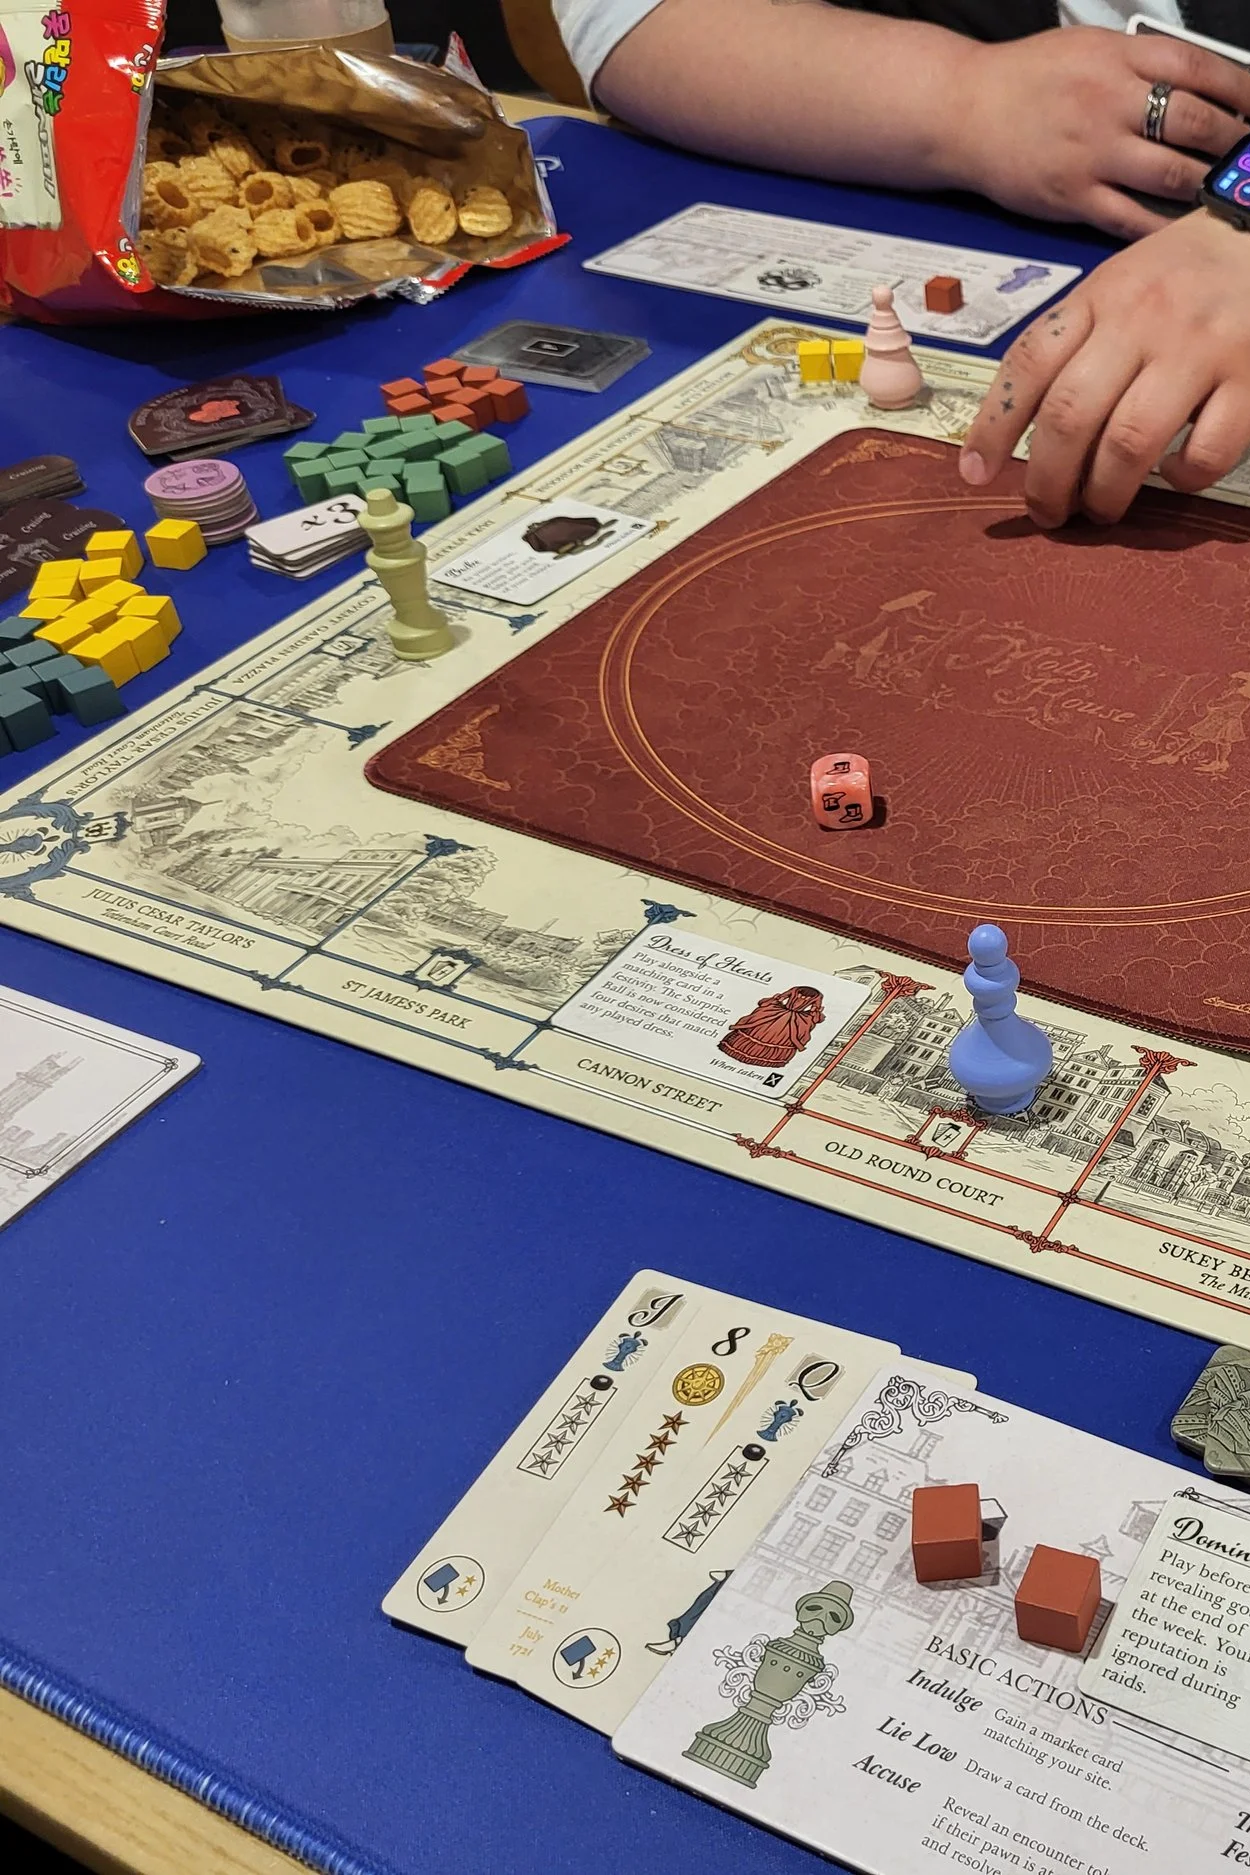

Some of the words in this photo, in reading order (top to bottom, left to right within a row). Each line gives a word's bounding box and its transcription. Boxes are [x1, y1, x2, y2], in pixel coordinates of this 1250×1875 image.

[21, 510, 52, 534] Cruising
[62, 520, 98, 542] Cruising
[178, 696, 223, 727] JULIUS
[136, 725, 178, 755] CESAR
[66, 749, 138, 797] TAYLOR'S
[82, 888, 138, 910] JULIUS
[137, 905, 184, 926] CESAR
[185, 920, 256, 949] TAYLOR'S
[153, 925, 186, 941] Court
[184, 935, 216, 950] Road
[621, 962, 676, 986] matching
[675, 978, 702, 993] card
[632, 951, 657, 967] Play
[658, 961, 717, 984] alongside
[649, 934, 690, 957] Dress
[715, 956, 773, 983] Hearts
[342, 979, 366, 994] ST
[361, 984, 428, 1020] JAMES'S
[424, 1006, 474, 1030] PARK
[602, 981, 627, 996] Ball
[638, 993, 664, 1007] now
[664, 1001, 729, 1029] considered
[611, 971, 657, 992] festivity.
[660, 986, 683, 999] The
[684, 993, 732, 1016] Surprise
[580, 1002, 603, 1016] any
[601, 1006, 645, 1028] played
[643, 1021, 676, 1039] dress.
[617, 998, 657, 1018] desires
[657, 1013, 681, 1028] that
[682, 1021, 719, 1039] match
[577, 1057, 652, 1089] CANNON
[652, 1080, 722, 1113] STREET
[708, 1058, 737, 1073] When
[736, 1067, 765, 1082] taken
[824, 1140, 863, 1165] OLD
[864, 1152, 933, 1185] ROUND
[935, 1175, 1004, 1208] COURT
[1158, 1239, 1227, 1271] SUKEY
[1198, 1272, 1227, 1292] The
[627, 1293, 686, 1328] J
[711, 1326, 751, 1357] 8
[788, 1360, 840, 1402] Q
[1159, 1548, 1194, 1576] Play
[1149, 1568, 1227, 1611] revealing
[1131, 1606, 1161, 1630] the
[1162, 1616, 1210, 1647] week.
[1158, 1591, 1189, 1615] the
[1191, 1606, 1224, 1631] end
[1227, 1617, 1250, 1638] of
[1120, 1625, 1211, 1671] reputation
[906, 1668, 984, 1713] Indulge
[924, 1635, 998, 1677] BASIC
[997, 1668, 1110, 1726] ACTIONS
[1101, 1665, 1148, 1695] raids.
[1111, 1644, 1178, 1684] ignored
[1180, 1672, 1243, 1710] during
[876, 1715, 913, 1744] Lie
[912, 1731, 959, 1764] Low
[983, 1726, 1049, 1765] matching
[1047, 1754, 1084, 1779] your
[1084, 1767, 1113, 1791] site.
[994, 1707, 1028, 1733] Gain
[1041, 1731, 1090, 1764] market
[1091, 1750, 1125, 1775] card
[852, 1752, 923, 1795] Accuse
[963, 1758, 1004, 1786] Draw
[1015, 1783, 1048, 1806] card
[1048, 1796, 1083, 1822] from
[1085, 1813, 1111, 1834] the
[1112, 1824, 1150, 1853] deck.
[921, 1834, 951, 1856] and
[942, 1795, 991, 1828] Reveal
[1012, 1831, 1086, 1871] encounter
[945, 1822, 981, 1847] their
[979, 1840, 1022, 1867] pawn
